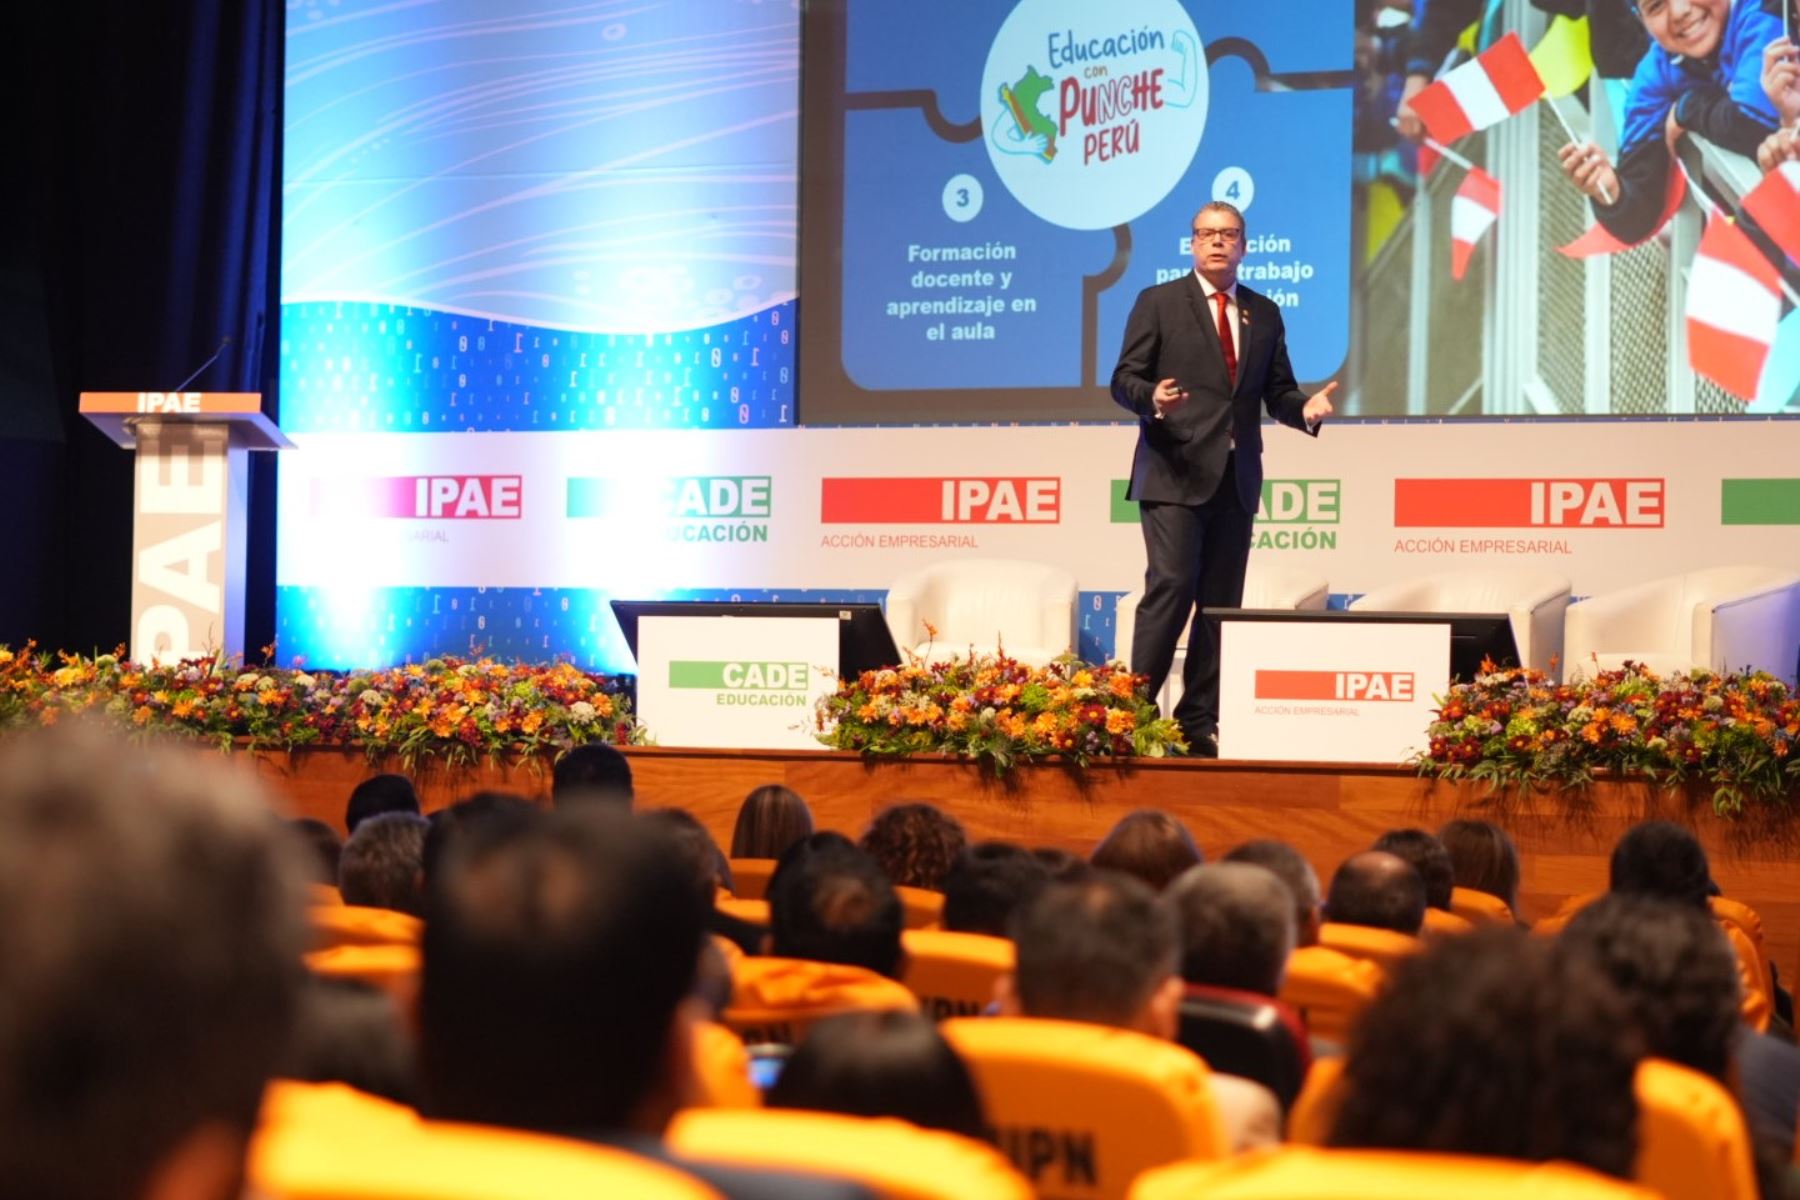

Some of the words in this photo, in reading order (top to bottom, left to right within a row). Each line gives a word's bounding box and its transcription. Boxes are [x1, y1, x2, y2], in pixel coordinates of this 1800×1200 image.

[1048, 25, 1165, 69] Educación
[1084, 66, 1108, 79] con
[1084, 119, 1140, 166] PERÚ
[956, 188, 970, 208] 3
[1226, 180, 1241, 200] 4
[908, 241, 1017, 263] Formación
[1179, 234, 1292, 256] Eción
[911, 269, 994, 288] docente
[1000, 271, 1013, 290] y
[1156, 268, 1193, 284] par
[1236, 261, 1314, 283] trabajo
[886, 296, 1005, 319] aprendizaje
[1011, 298, 1037, 313] en
[926, 323, 945, 341] el
[952, 322, 996, 341] aula
[137, 392, 202, 413] IPAE
[415, 478, 520, 517] IPAE
[655, 479, 769, 516] ADE
[942, 480, 1058, 520] IPAE
[1530, 482, 1661, 524] IPAE
[821, 532, 875, 548] ACCIÓN
[879, 535, 979, 549] EMPRESARIAL
[1394, 537, 1456, 553] ACCIÓN
[1460, 540, 1573, 554] EMPRESARIAL
[136, 440, 223, 669] PAE
[722, 663, 807, 689] CADE
[1335, 673, 1413, 701] IPAE
[716, 693, 807, 707] EDUCACIÓN
[1254, 704, 1291, 716] ACCIÓN
[1293, 706, 1361, 717] EMPRESARIAL
